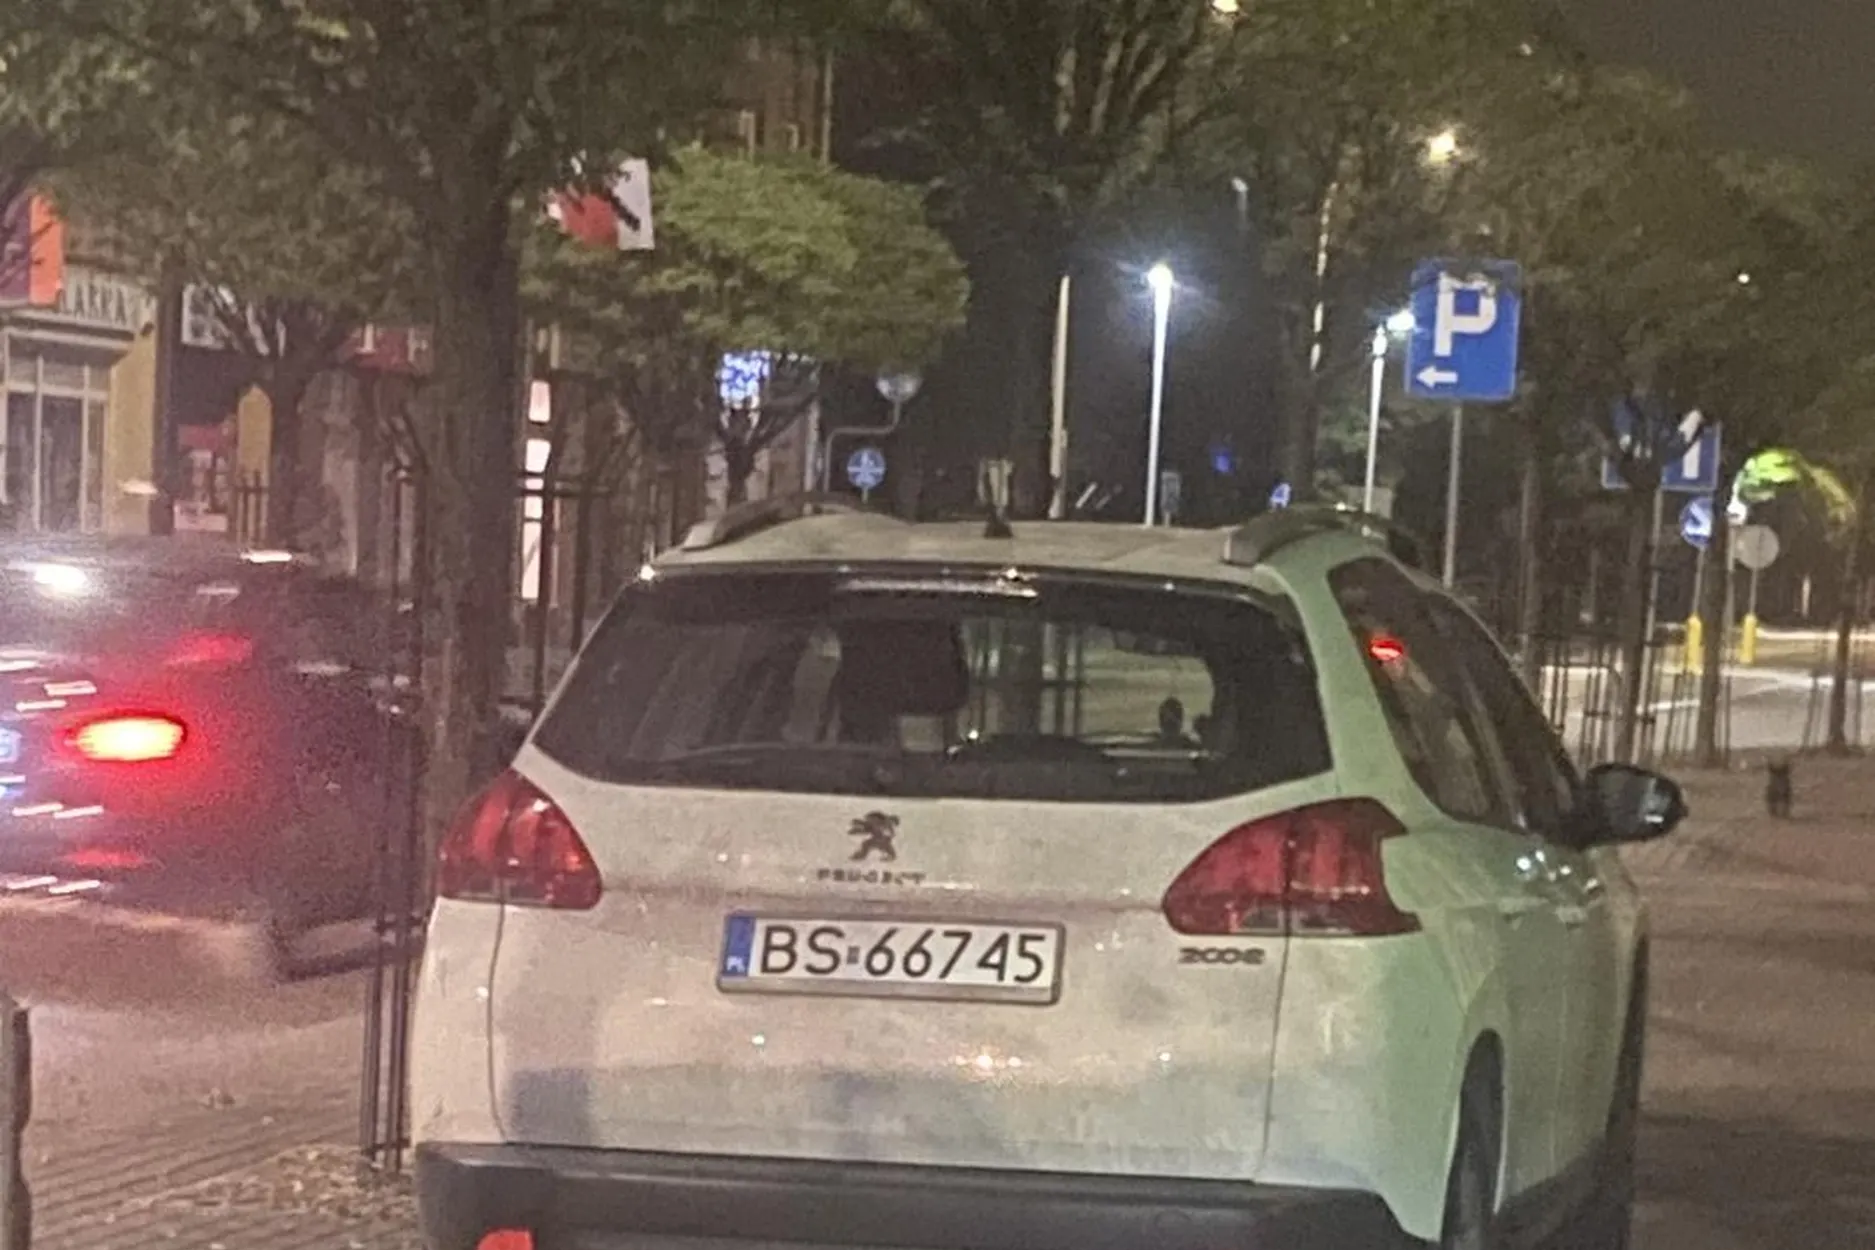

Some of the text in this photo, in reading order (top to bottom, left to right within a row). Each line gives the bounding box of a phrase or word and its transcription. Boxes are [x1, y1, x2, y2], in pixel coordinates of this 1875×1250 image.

[1433, 271, 1497, 357] P
[760, 925, 1046, 983] BS 66745
